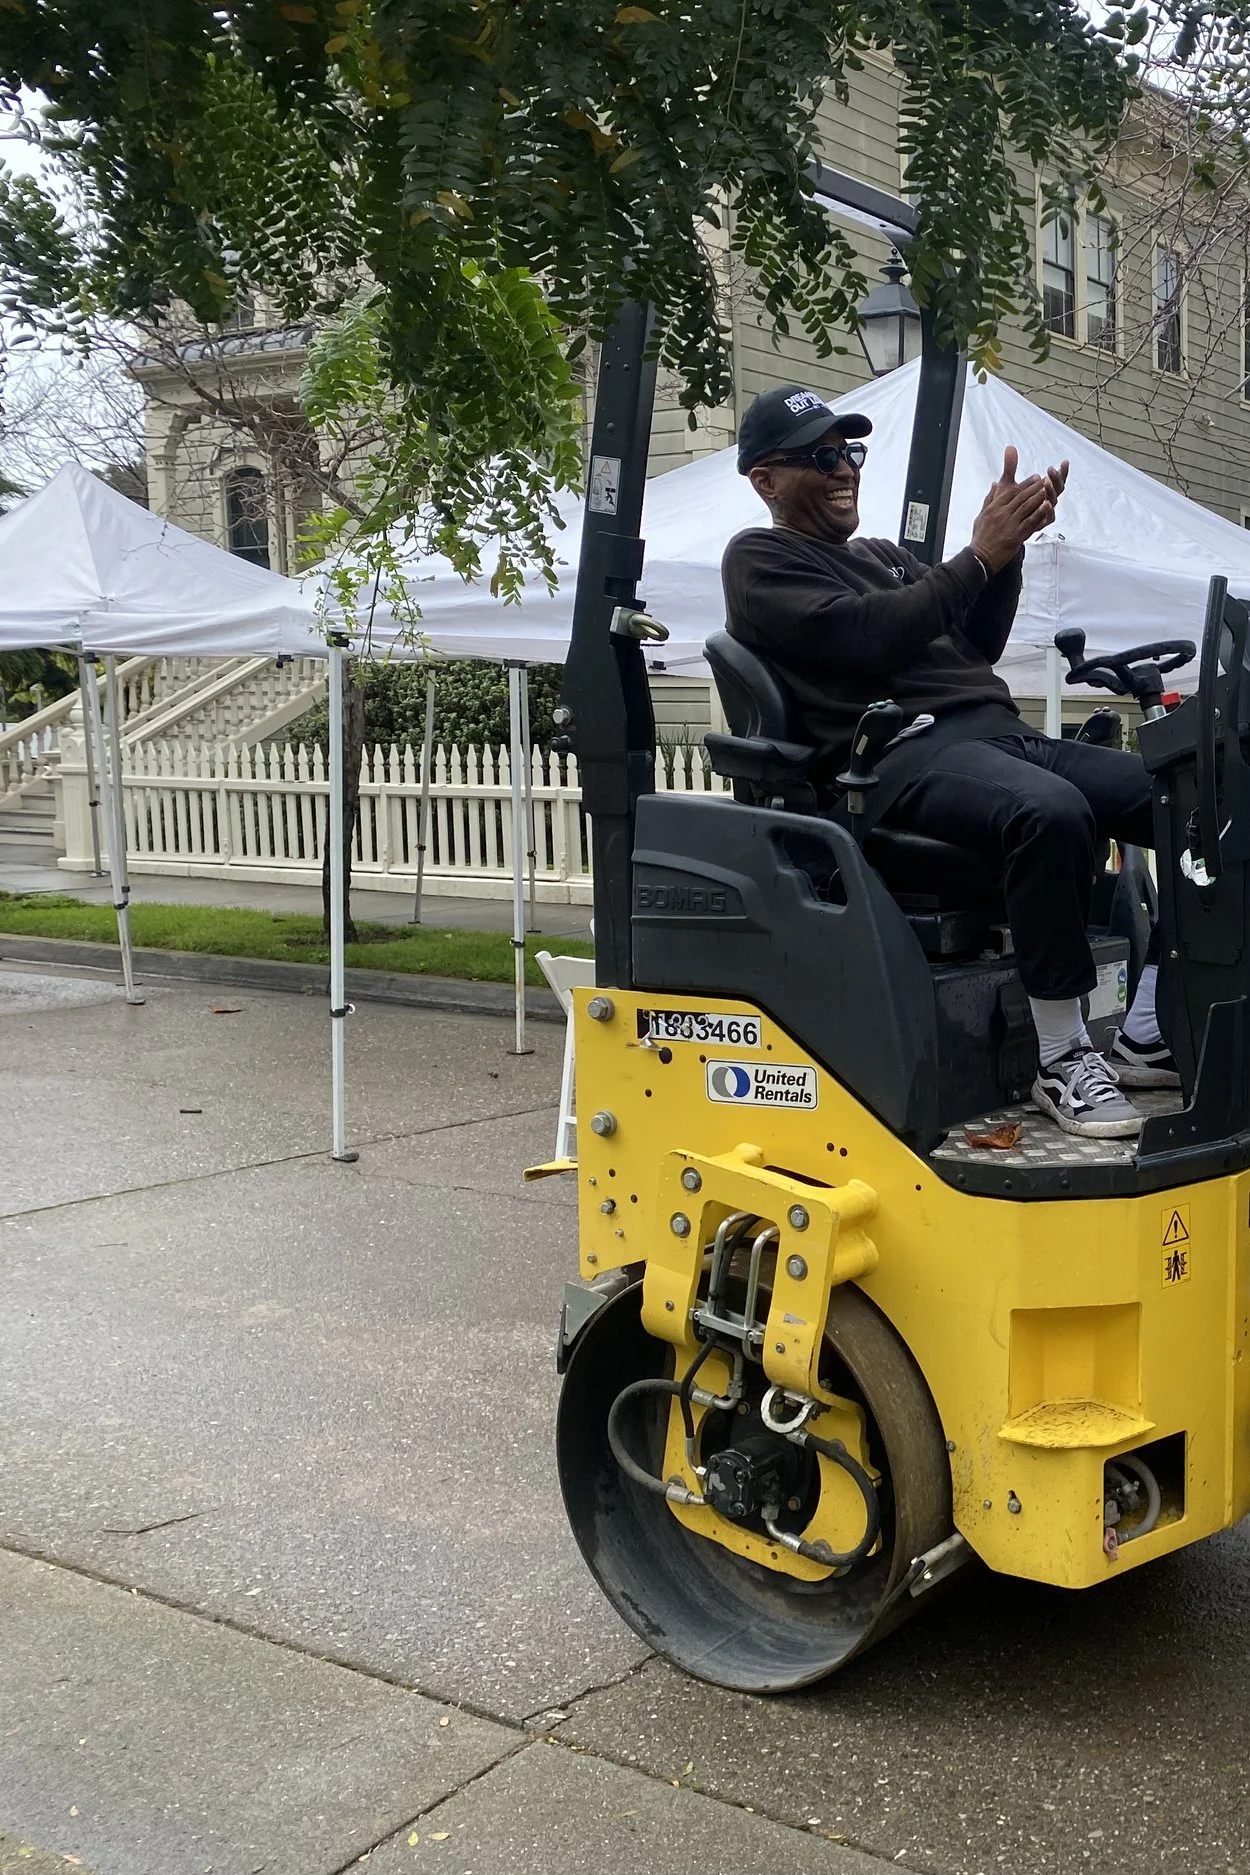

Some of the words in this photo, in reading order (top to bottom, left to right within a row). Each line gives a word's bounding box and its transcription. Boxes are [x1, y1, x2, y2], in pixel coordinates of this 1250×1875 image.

[790, 399, 810, 413] OUT
[635, 884, 727, 912] BOMAG
[754, 1069, 807, 1087] United
[754, 1086, 812, 1104] Rentals
